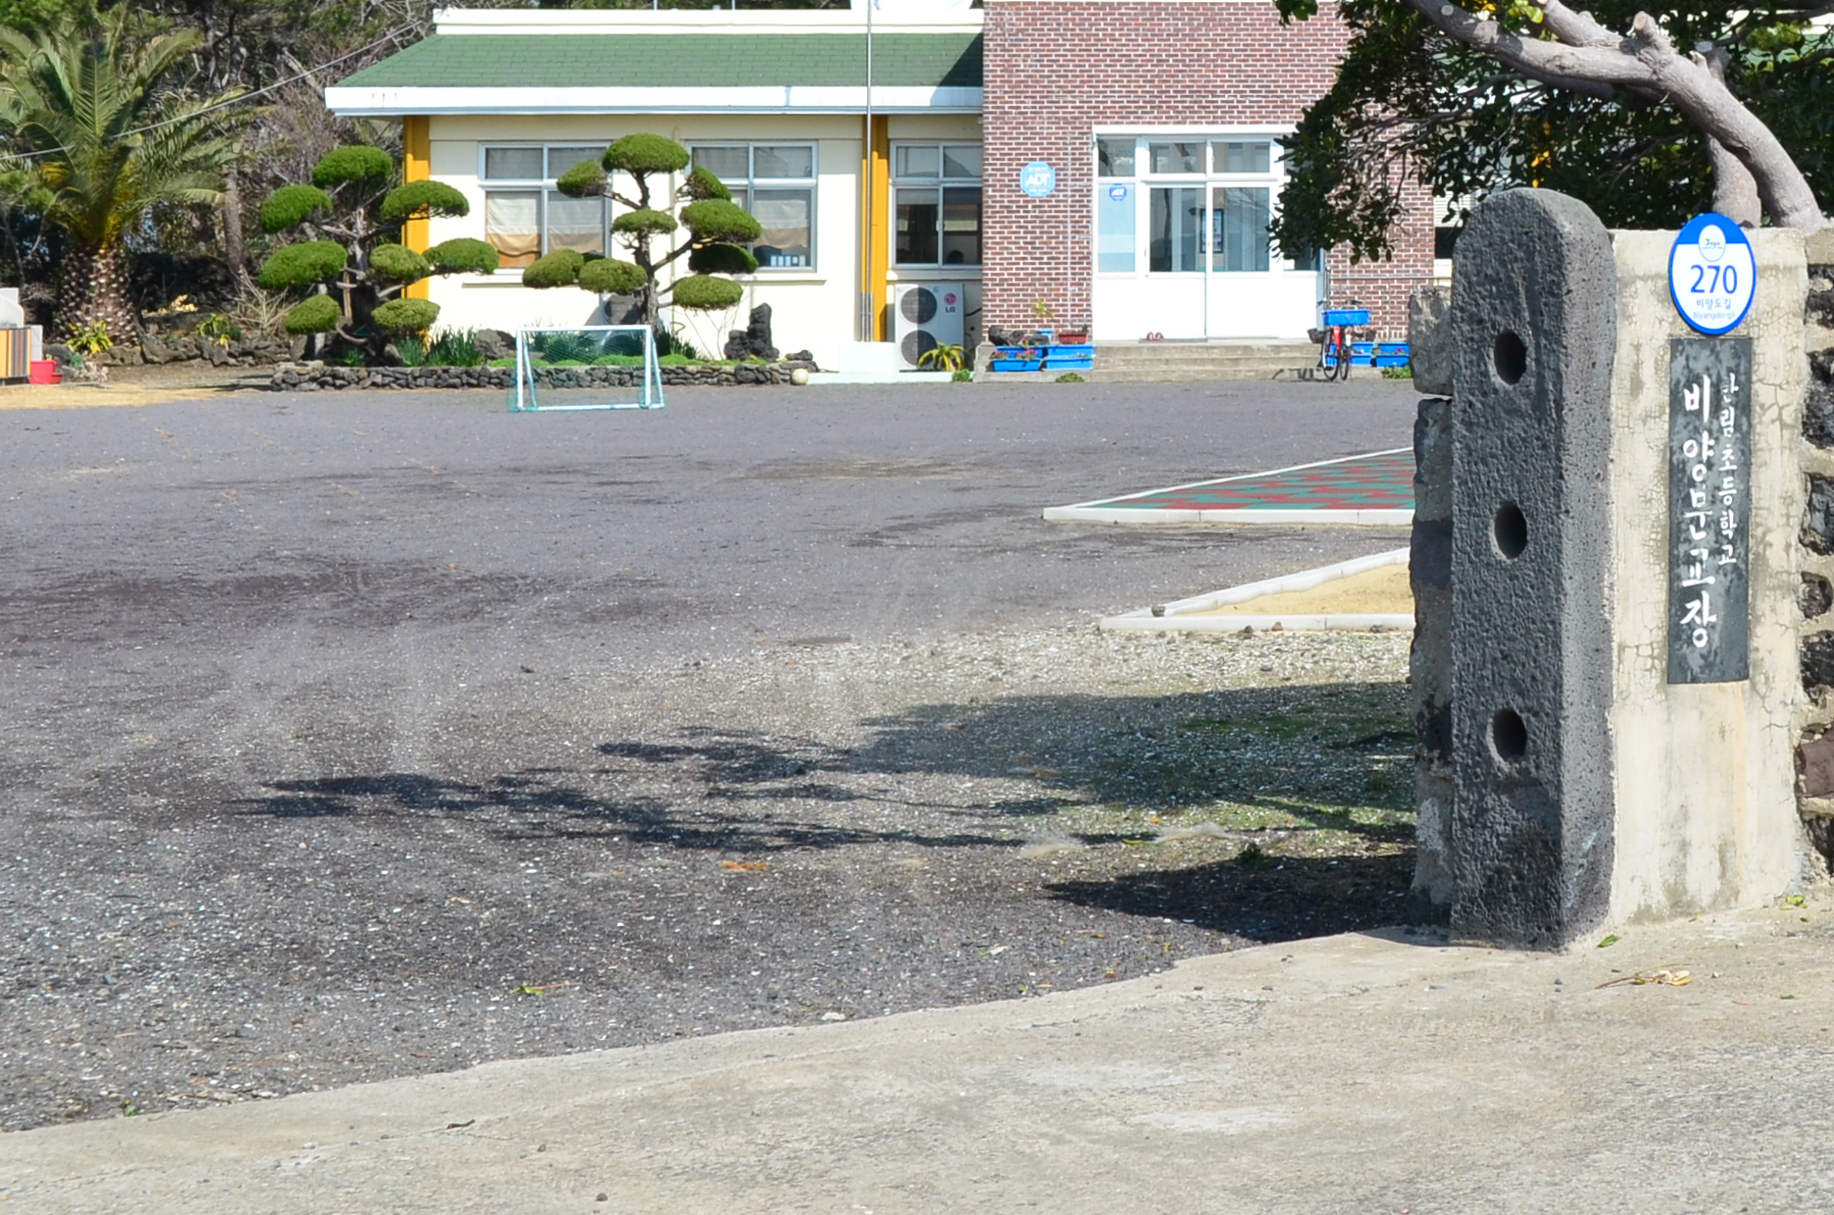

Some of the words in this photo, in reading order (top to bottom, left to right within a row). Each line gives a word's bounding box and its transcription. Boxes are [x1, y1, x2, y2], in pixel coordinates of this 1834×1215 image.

[1025, 173, 1051, 186] ADT
[1690, 264, 1738, 294] 270
[1696, 298, 1732, 311] 비양도길
[1693, 311, 1736, 321] Biyangdo-gil
[1717, 372, 1740, 566] 한림초등학교
[1680, 374, 1717, 648] 비양분교장
